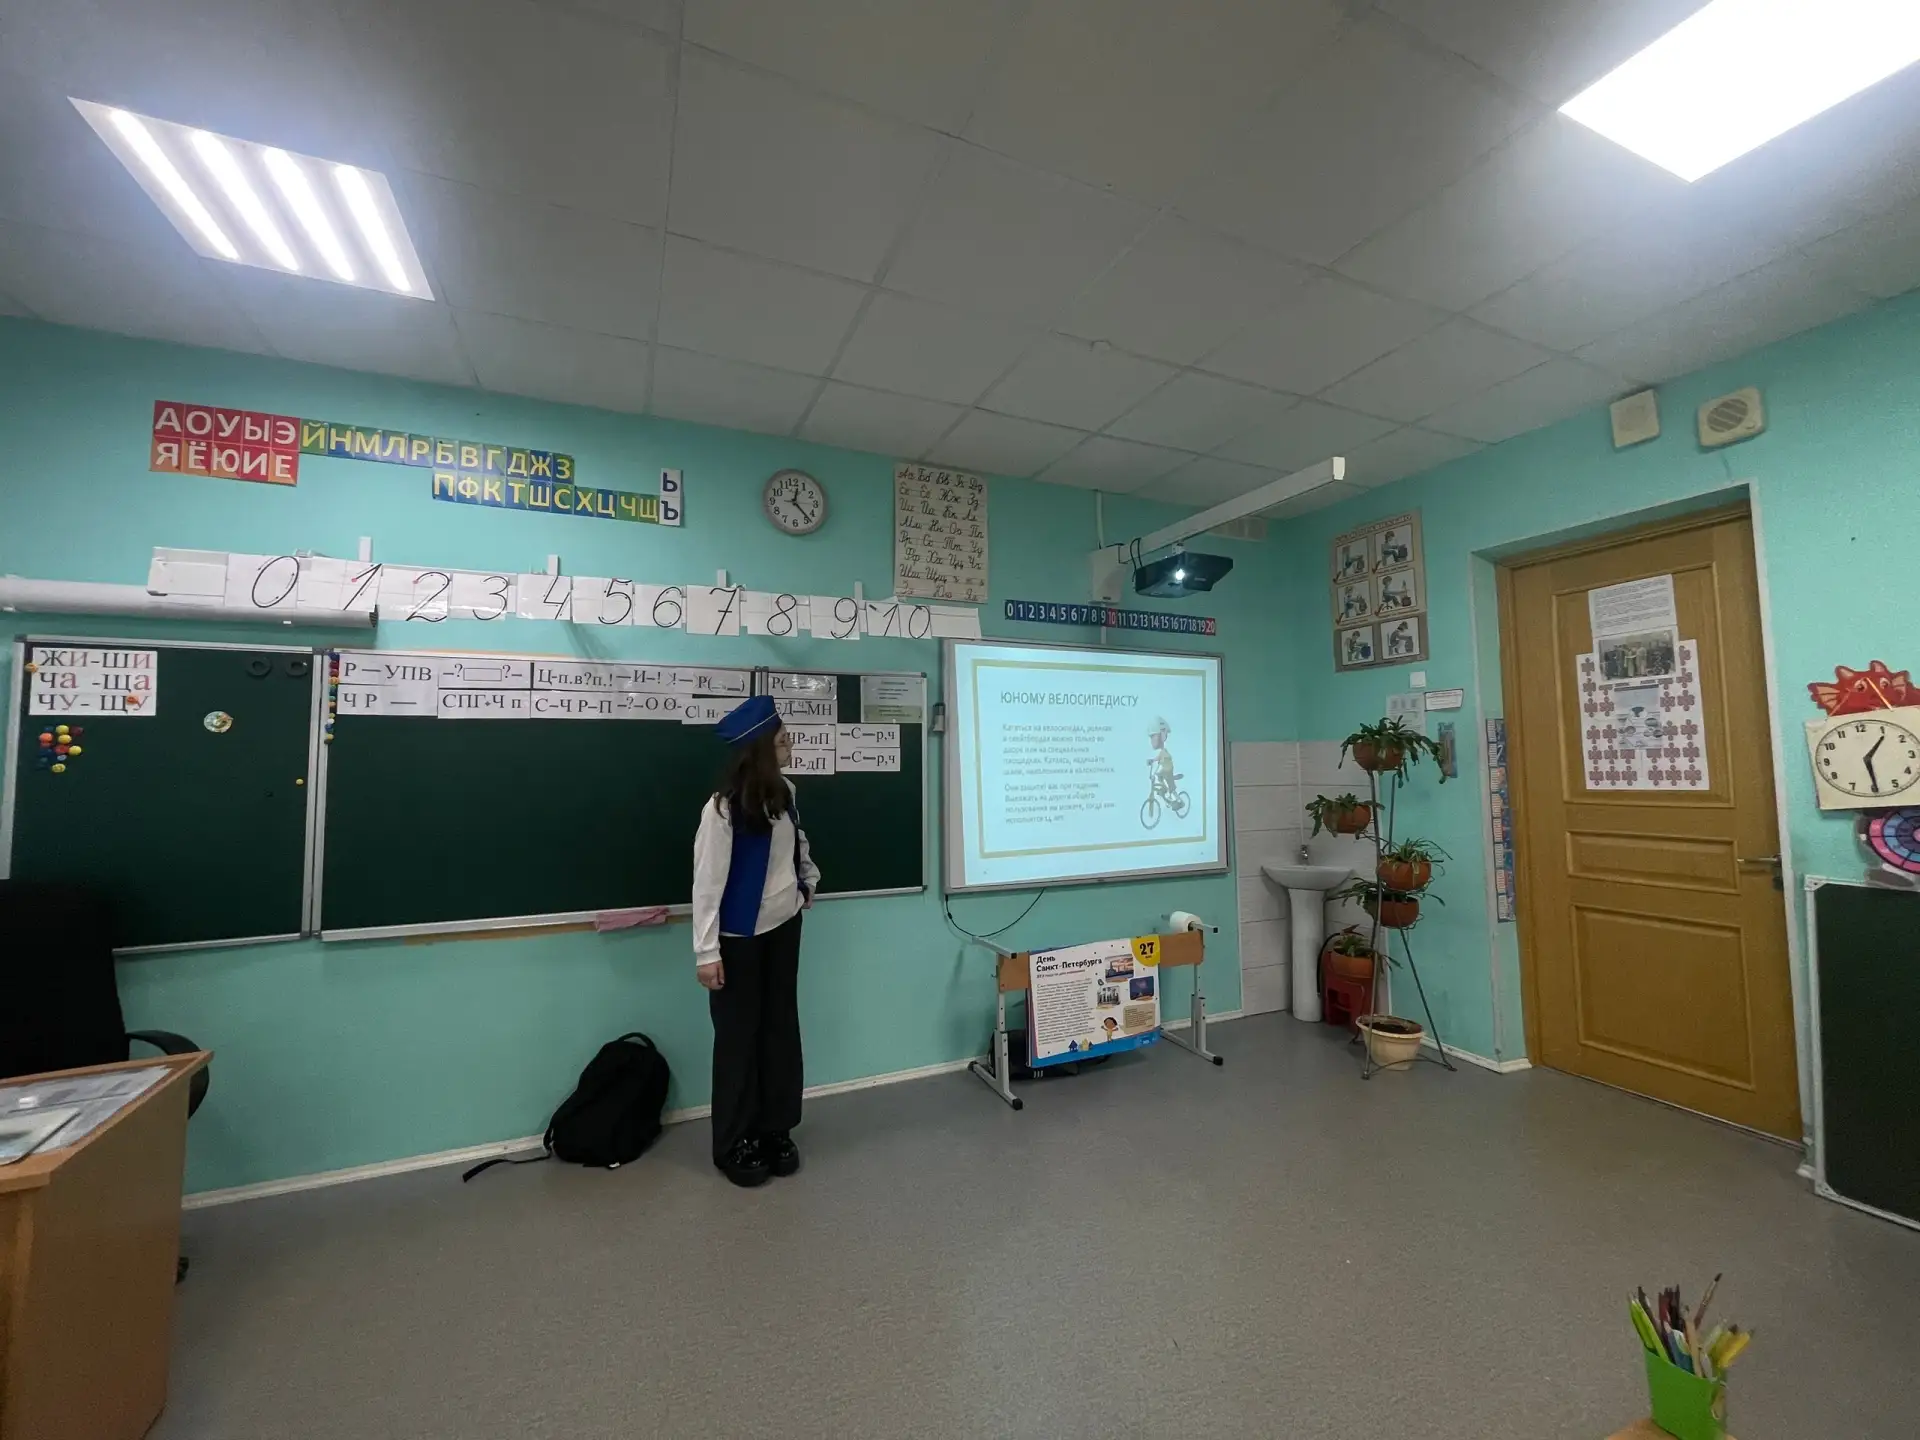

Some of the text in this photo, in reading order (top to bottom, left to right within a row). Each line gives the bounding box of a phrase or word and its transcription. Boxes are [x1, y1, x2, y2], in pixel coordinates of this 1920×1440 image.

[780, 480, 789, 489] 11
[788, 478, 799, 487] 12
[801, 482, 806, 491] 1
[772, 488, 783, 497] 10
[808, 490, 814, 499] 2
[769, 497, 776, 506] 9
[812, 499, 819, 509] 3
[773, 506, 780, 515] 8
[809, 509, 816, 517] 4
[782, 515, 788, 523] 7
[792, 518, 799, 528] 6
[803, 516, 810, 525] 5
[252, 555, 931, 640] 0 1 2 3 4 5 6 7 8 9 10
[1007, 603, 1215, 633] 0 1 2 3 4 5 6 7 8 9 10 11 12 13 14 15 16 17 18 19 20
[1000, 691, 1139, 709] ЮНОМУ ВЕЛОСИПЕДИСТУ
[1854, 724, 1867, 733] 12
[1880, 725, 1886, 735] 1
[1837, 730, 1846, 739] 11
[1898, 734, 1907, 744] 2
[1824, 742, 1836, 751] 10
[1907, 749, 1916, 759] 3
[1823, 757, 1831, 767] 9
[1903, 766, 1912, 775] 4
[1830, 771, 1838, 780] 8
[1848, 782, 1856, 791] 7
[1891, 778, 1900, 788] 5
[1139, 941, 1155, 956] 27
[1035, 954, 1056, 965] День
[1035, 957, 1103, 972] Санкт-Петербурга
